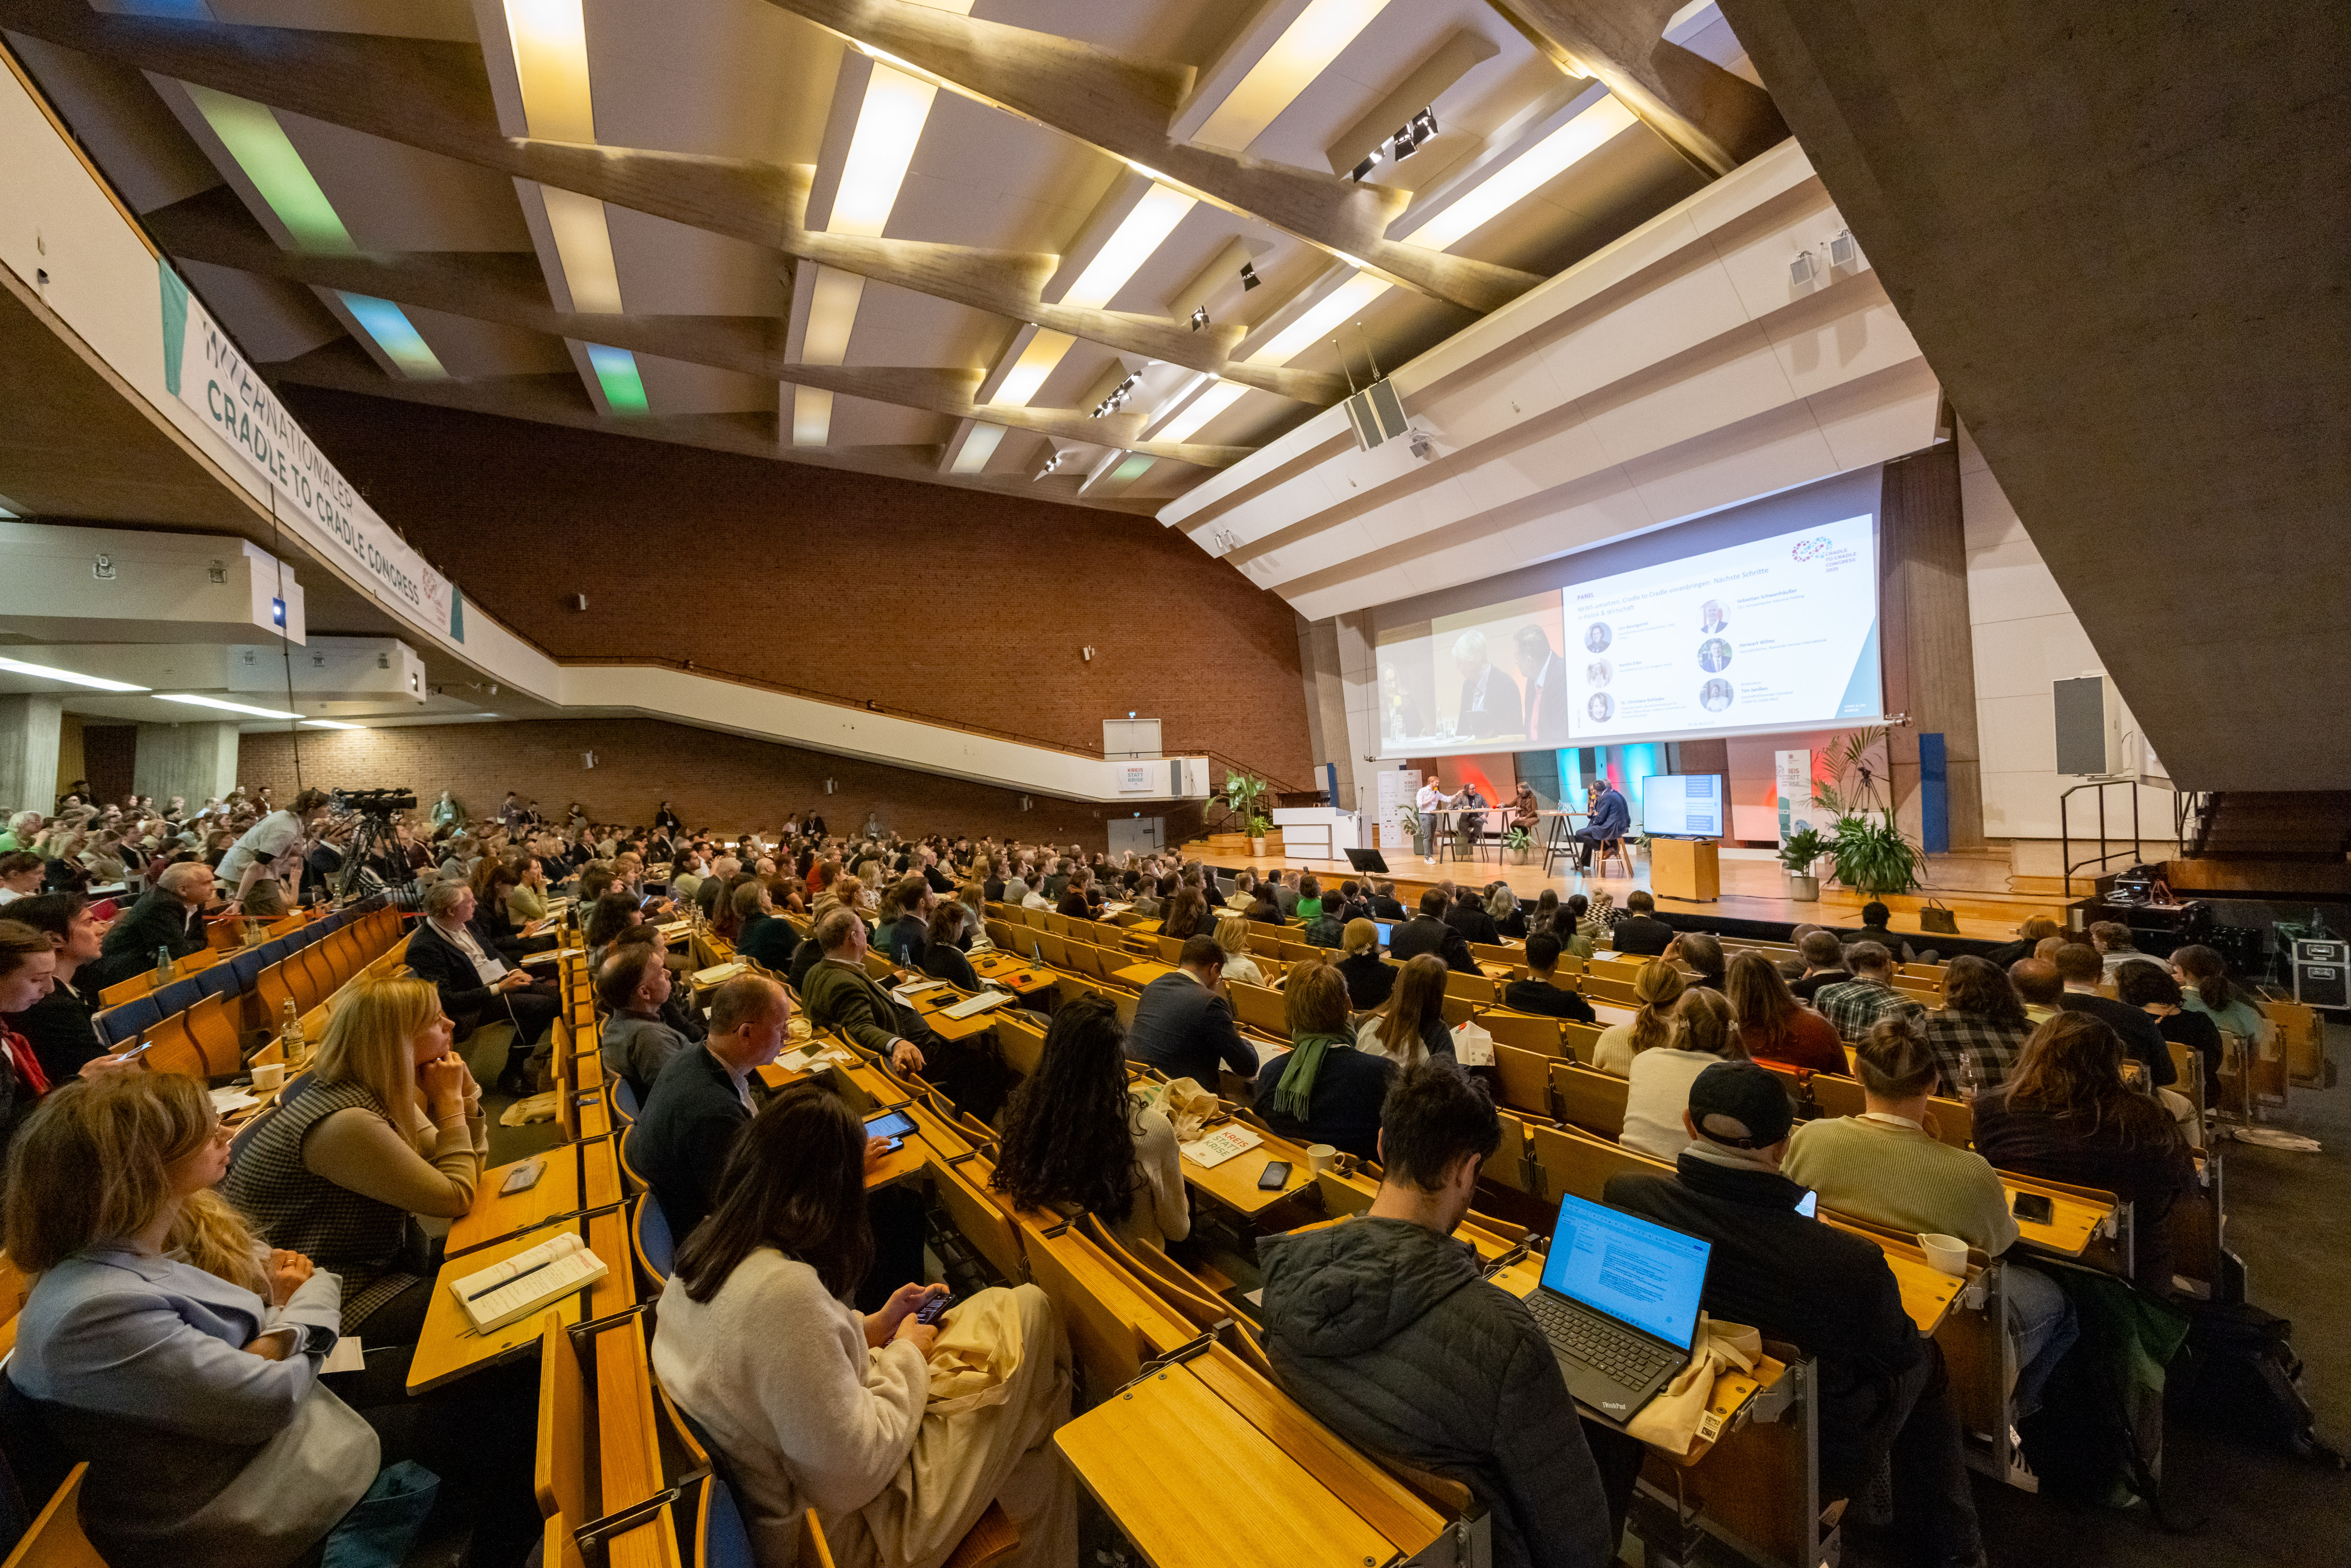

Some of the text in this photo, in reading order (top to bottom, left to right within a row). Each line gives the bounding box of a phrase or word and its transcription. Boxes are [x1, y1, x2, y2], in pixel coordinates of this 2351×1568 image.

[208, 379, 419, 605] CRADLE TO CRADLE CONGRESS
[1825, 548, 1848, 557] CRADLE
[1826, 558, 1856, 567] CONGRESS
[1594, 599, 1621, 611] umsetzen,
[1622, 594, 1640, 603] Cradle
[1649, 589, 1667, 597] Cradle
[1669, 579, 1712, 594] voranbringen:
[1714, 573, 1741, 584] Nächste
[1742, 567, 1769, 578] Schritte
[1584, 610, 1599, 619] Politik
[1607, 604, 1634, 615] Wirtschaft
[1213, 1135, 1240, 1152] STATT
[1221, 1132, 1249, 1148] KREIS
[1203, 1140, 1230, 1157] KRISE
